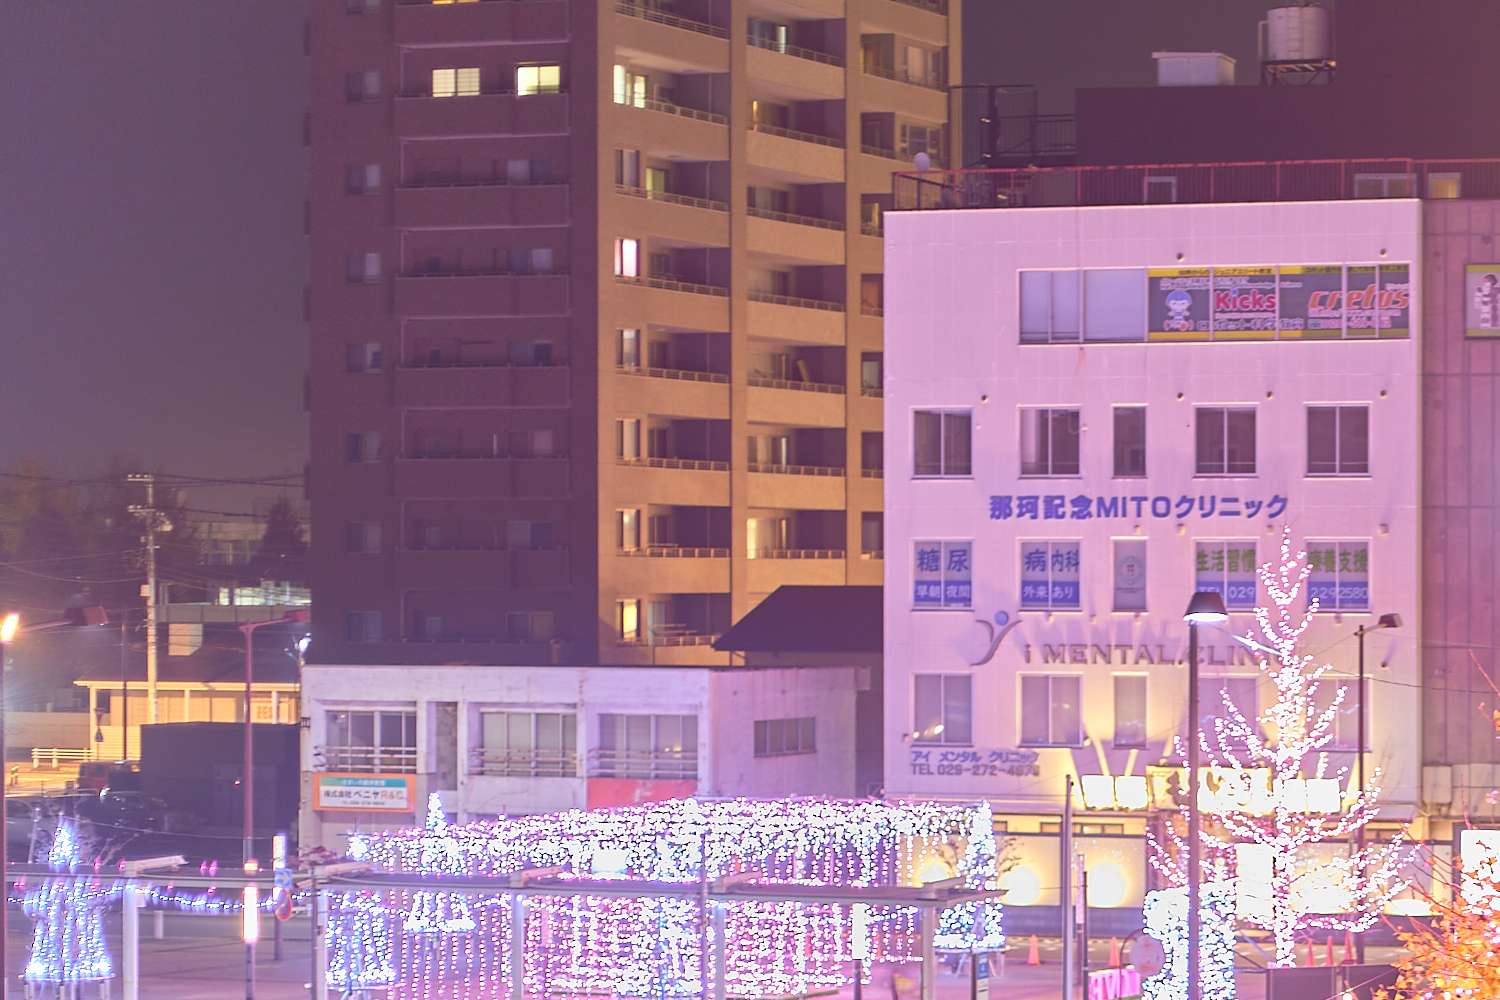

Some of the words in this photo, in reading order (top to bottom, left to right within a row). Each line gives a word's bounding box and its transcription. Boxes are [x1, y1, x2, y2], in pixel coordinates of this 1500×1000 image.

[1214, 289, 1277, 311] Kicks
[989, 495, 1288, 520] 那珂記念MITOクリニック
[917, 548, 969, 573] 糖尿
[1024, 548, 1080, 573] 病内科
[1196, 549, 1256, 573] 生活習慣
[1023, 585, 1074, 599] 外来あり
[1043, 644, 1176, 665] MENTAL
[939, 751, 981, 763] メンタル
[911, 764, 934, 775] TEL
